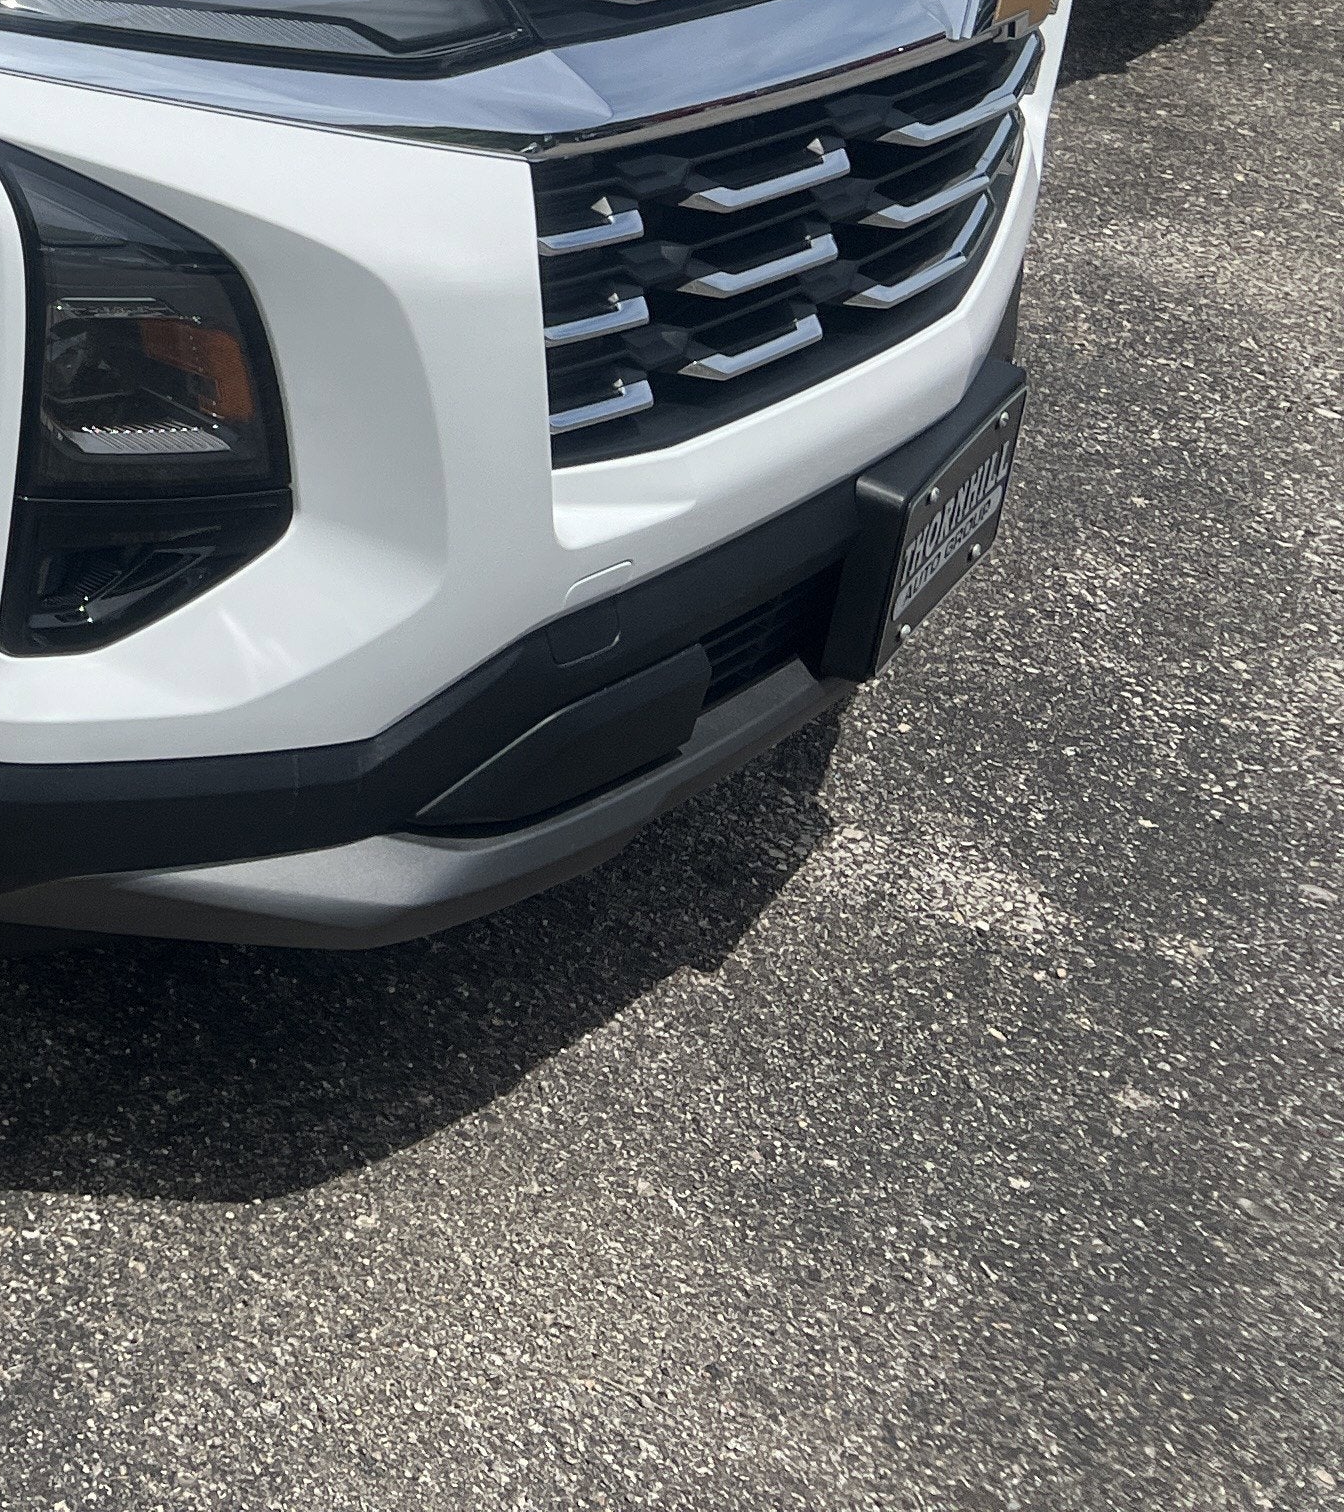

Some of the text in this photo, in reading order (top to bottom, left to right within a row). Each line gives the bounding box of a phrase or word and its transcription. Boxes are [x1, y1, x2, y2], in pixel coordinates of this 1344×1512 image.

[899, 440, 1010, 587] THORNHILL
[905, 500, 992, 599] AUTO GROUP
